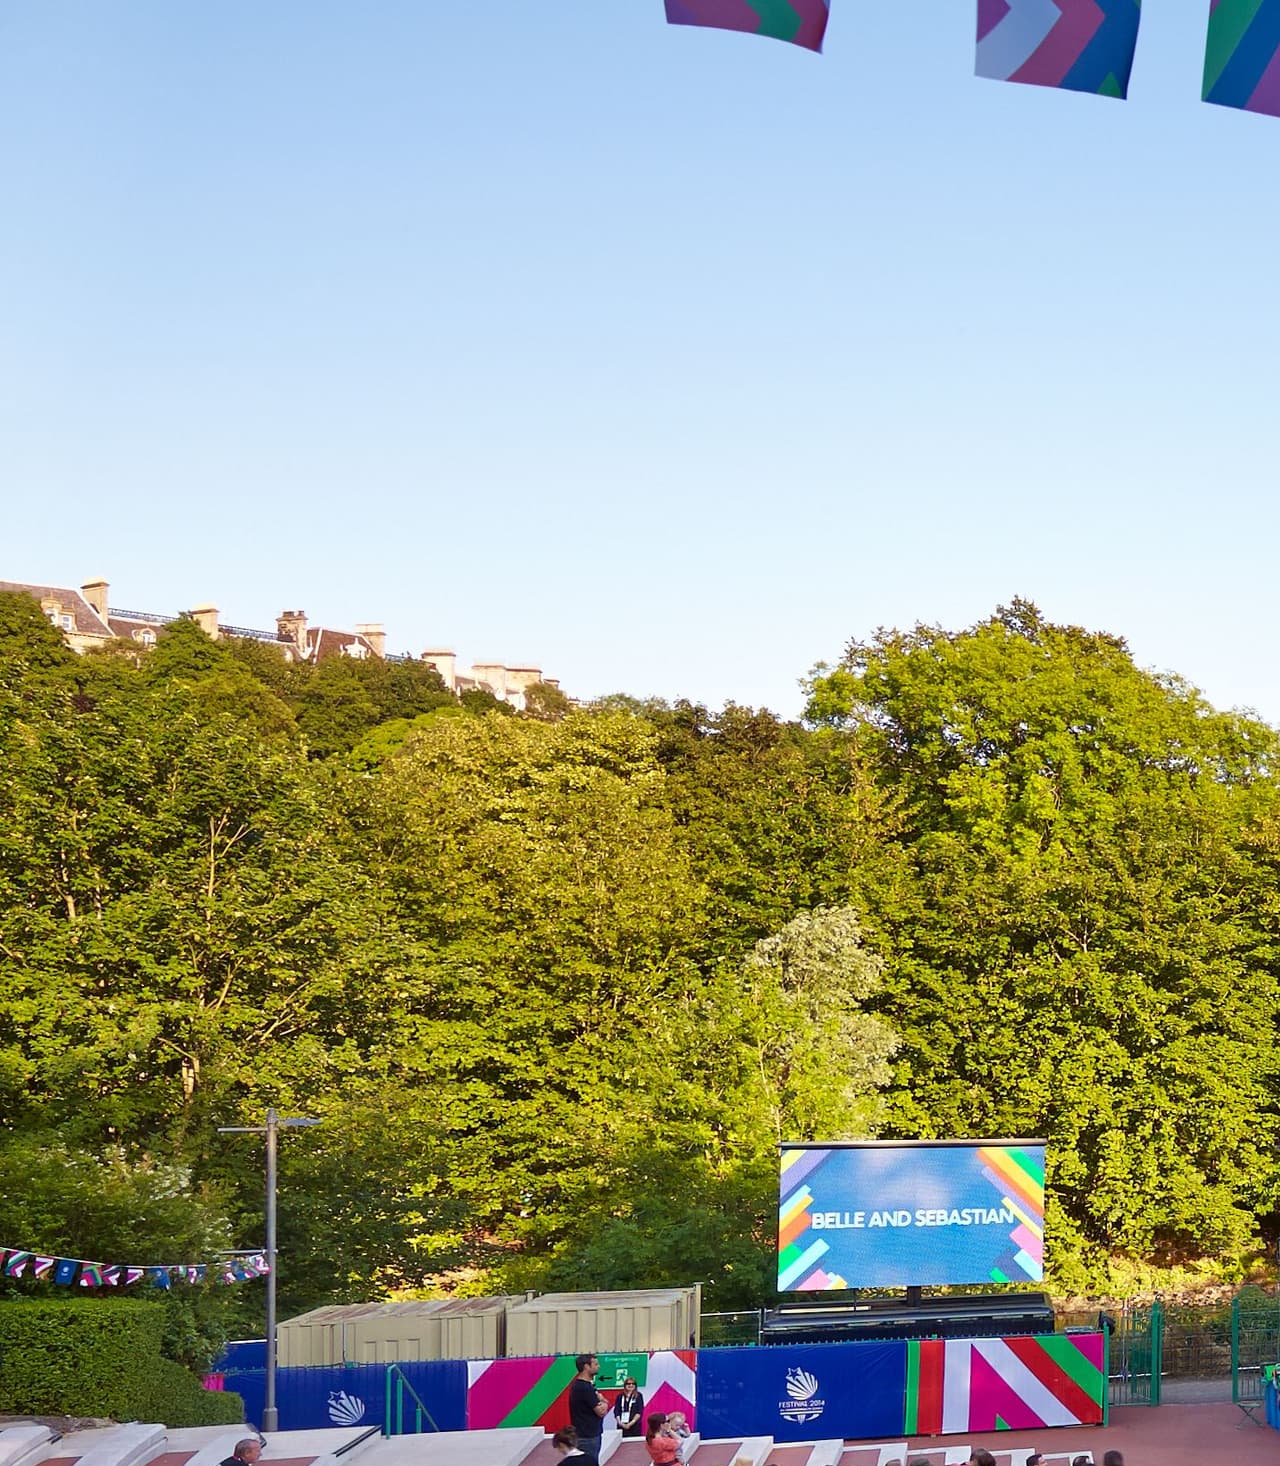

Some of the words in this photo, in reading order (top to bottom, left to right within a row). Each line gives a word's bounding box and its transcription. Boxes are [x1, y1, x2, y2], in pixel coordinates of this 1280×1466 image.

[811, 1211, 865, 1229] BELLE
[868, 1210, 912, 1228] AND
[914, 1207, 1014, 1227] SEBASTIAN
